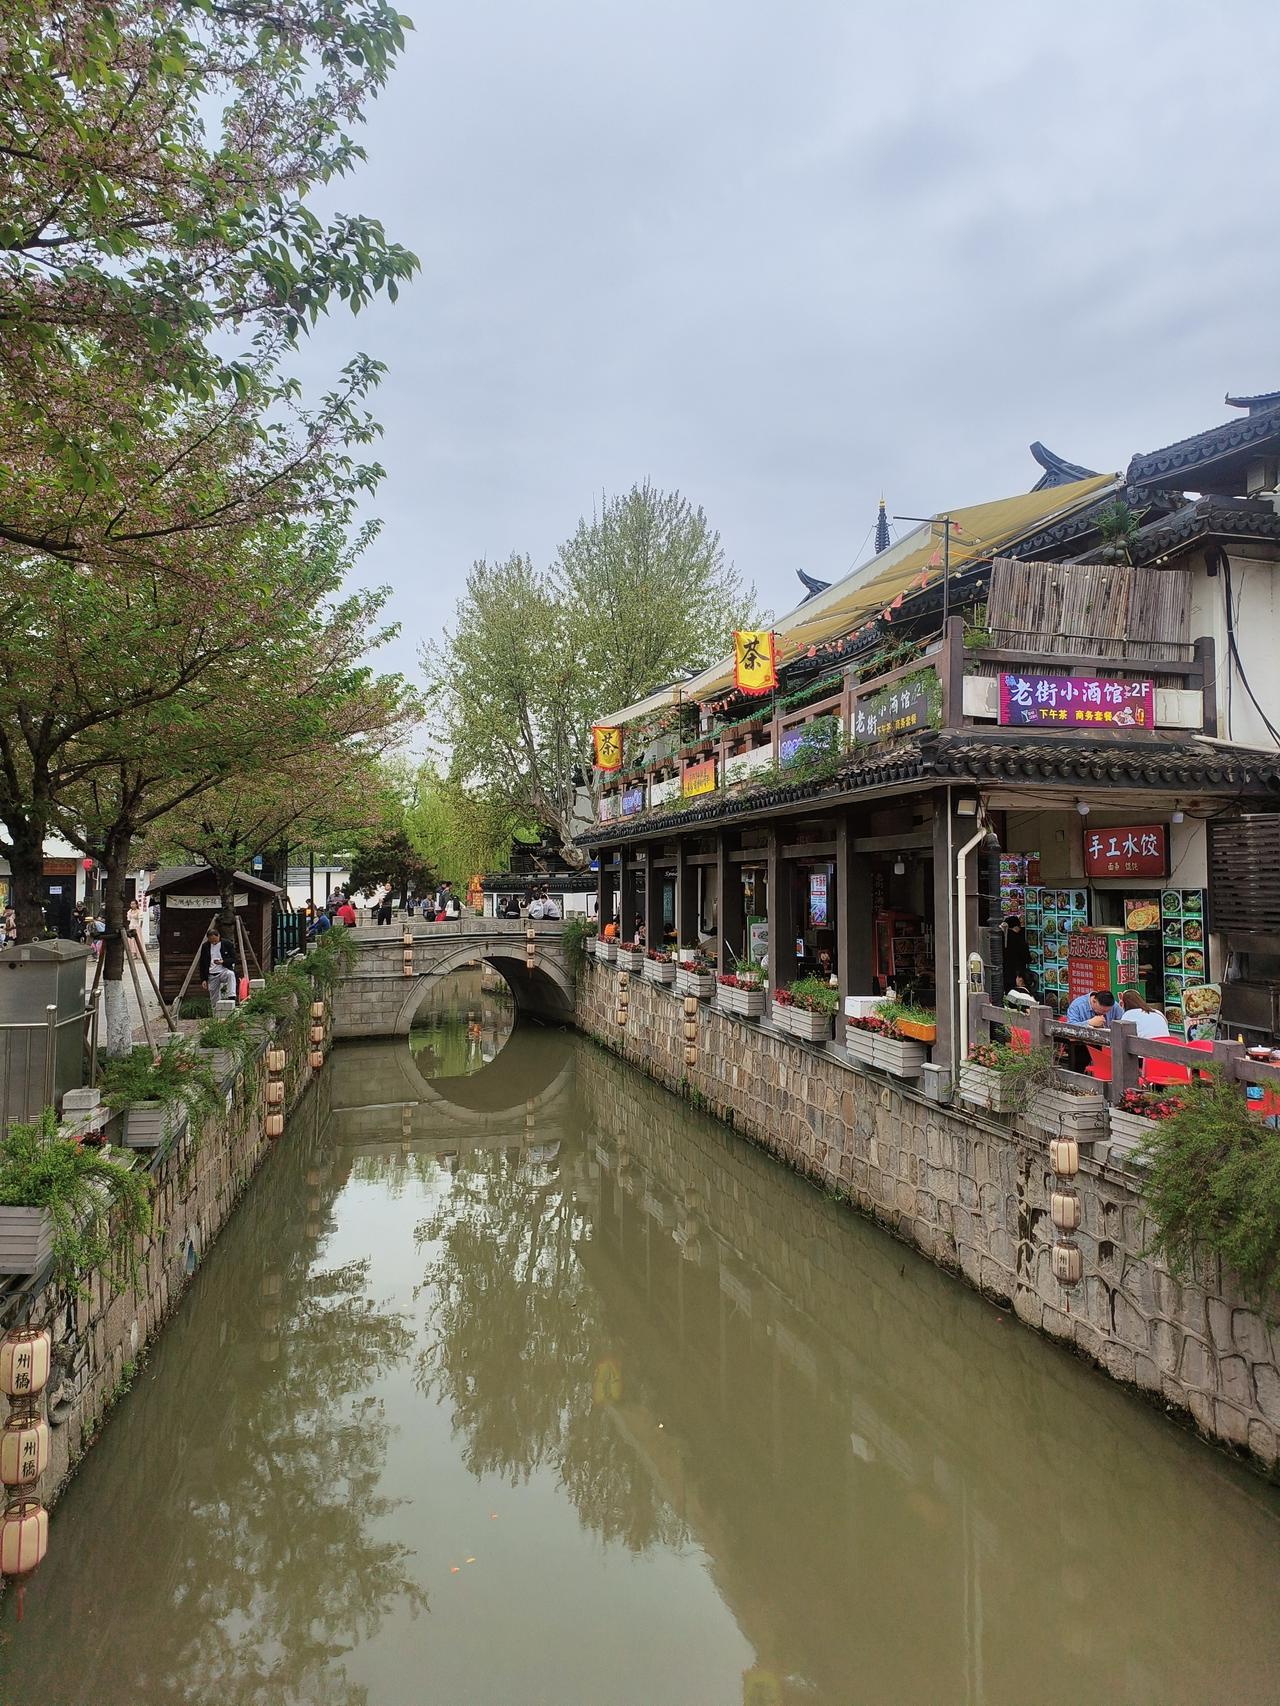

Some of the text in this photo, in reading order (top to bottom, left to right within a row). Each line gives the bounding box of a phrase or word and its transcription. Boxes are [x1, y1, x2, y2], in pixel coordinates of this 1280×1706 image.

[739, 635, 770, 671] 茶
[1010, 677, 1150, 707] 老街小酒馆 2F
[1039, 708, 1112, 722] 下午茶 商务套餐
[599, 732, 619, 756] 茶
[1088, 832, 1160, 860] 手工水饺
[15, 1353, 31, 1390] 州橋
[22, 1441, 36, 1478] 州橋
